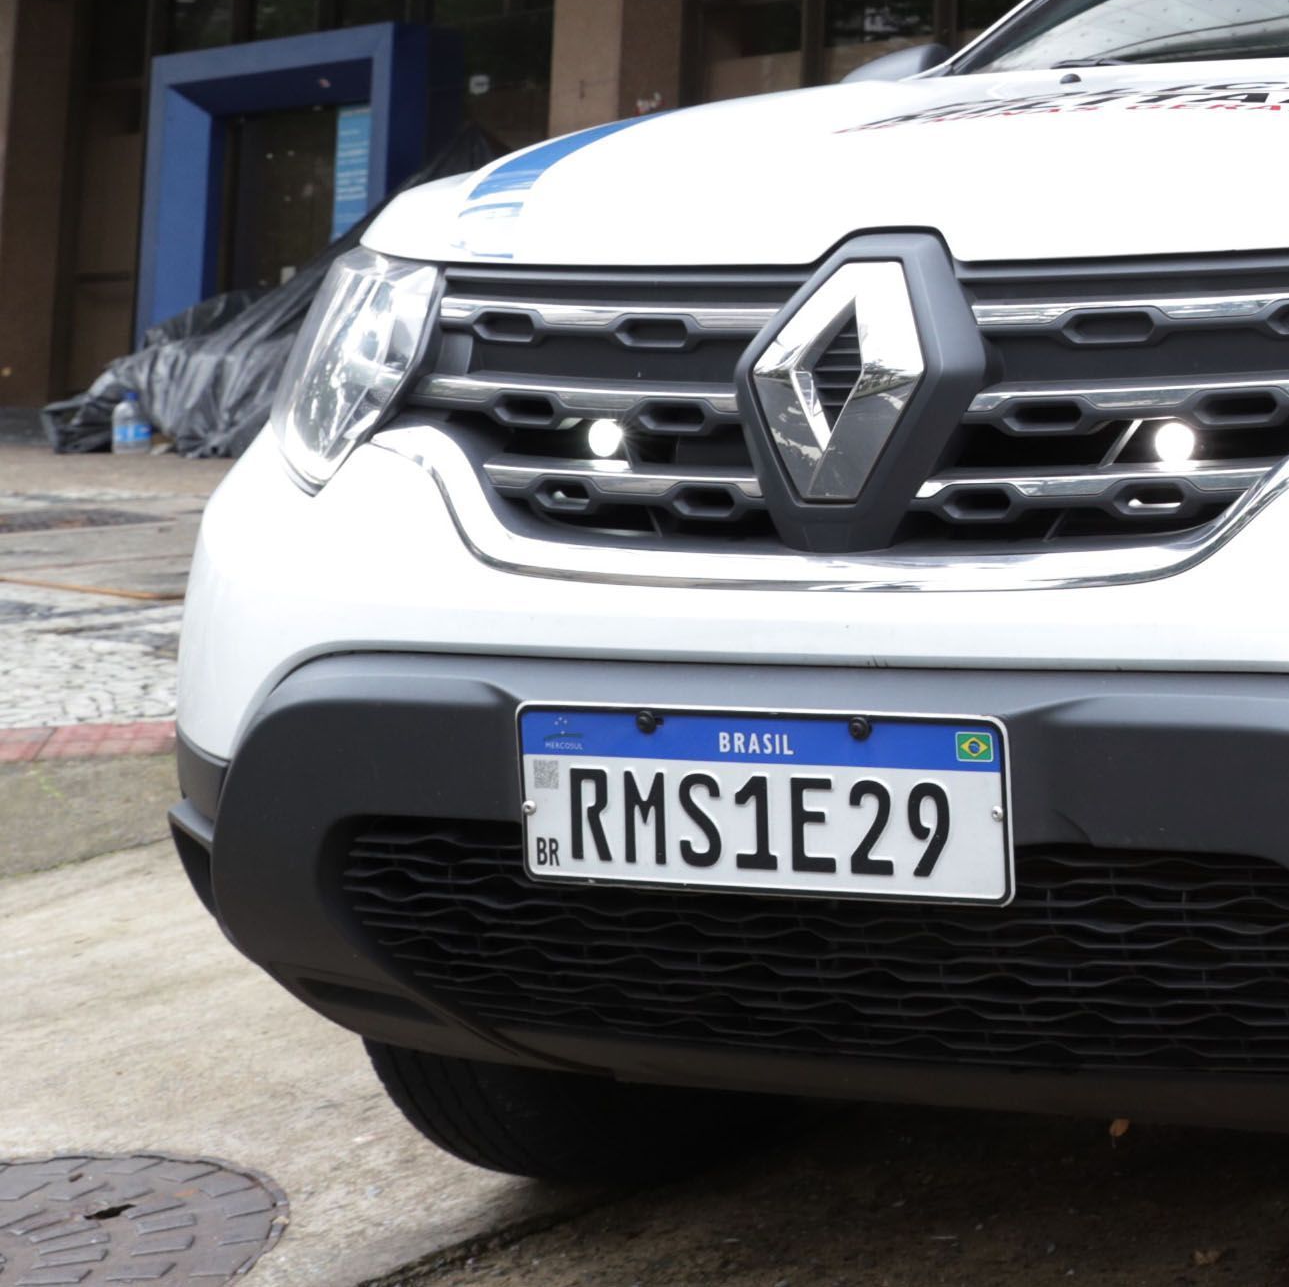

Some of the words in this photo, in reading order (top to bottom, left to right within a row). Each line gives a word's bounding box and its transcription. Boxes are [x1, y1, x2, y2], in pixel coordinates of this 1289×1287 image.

[544, 740, 584, 751] MERCOSUL
[718, 731, 795, 756] BRASIL
[568, 767, 951, 878] RMS1E29
[536, 836, 560, 867] BR
